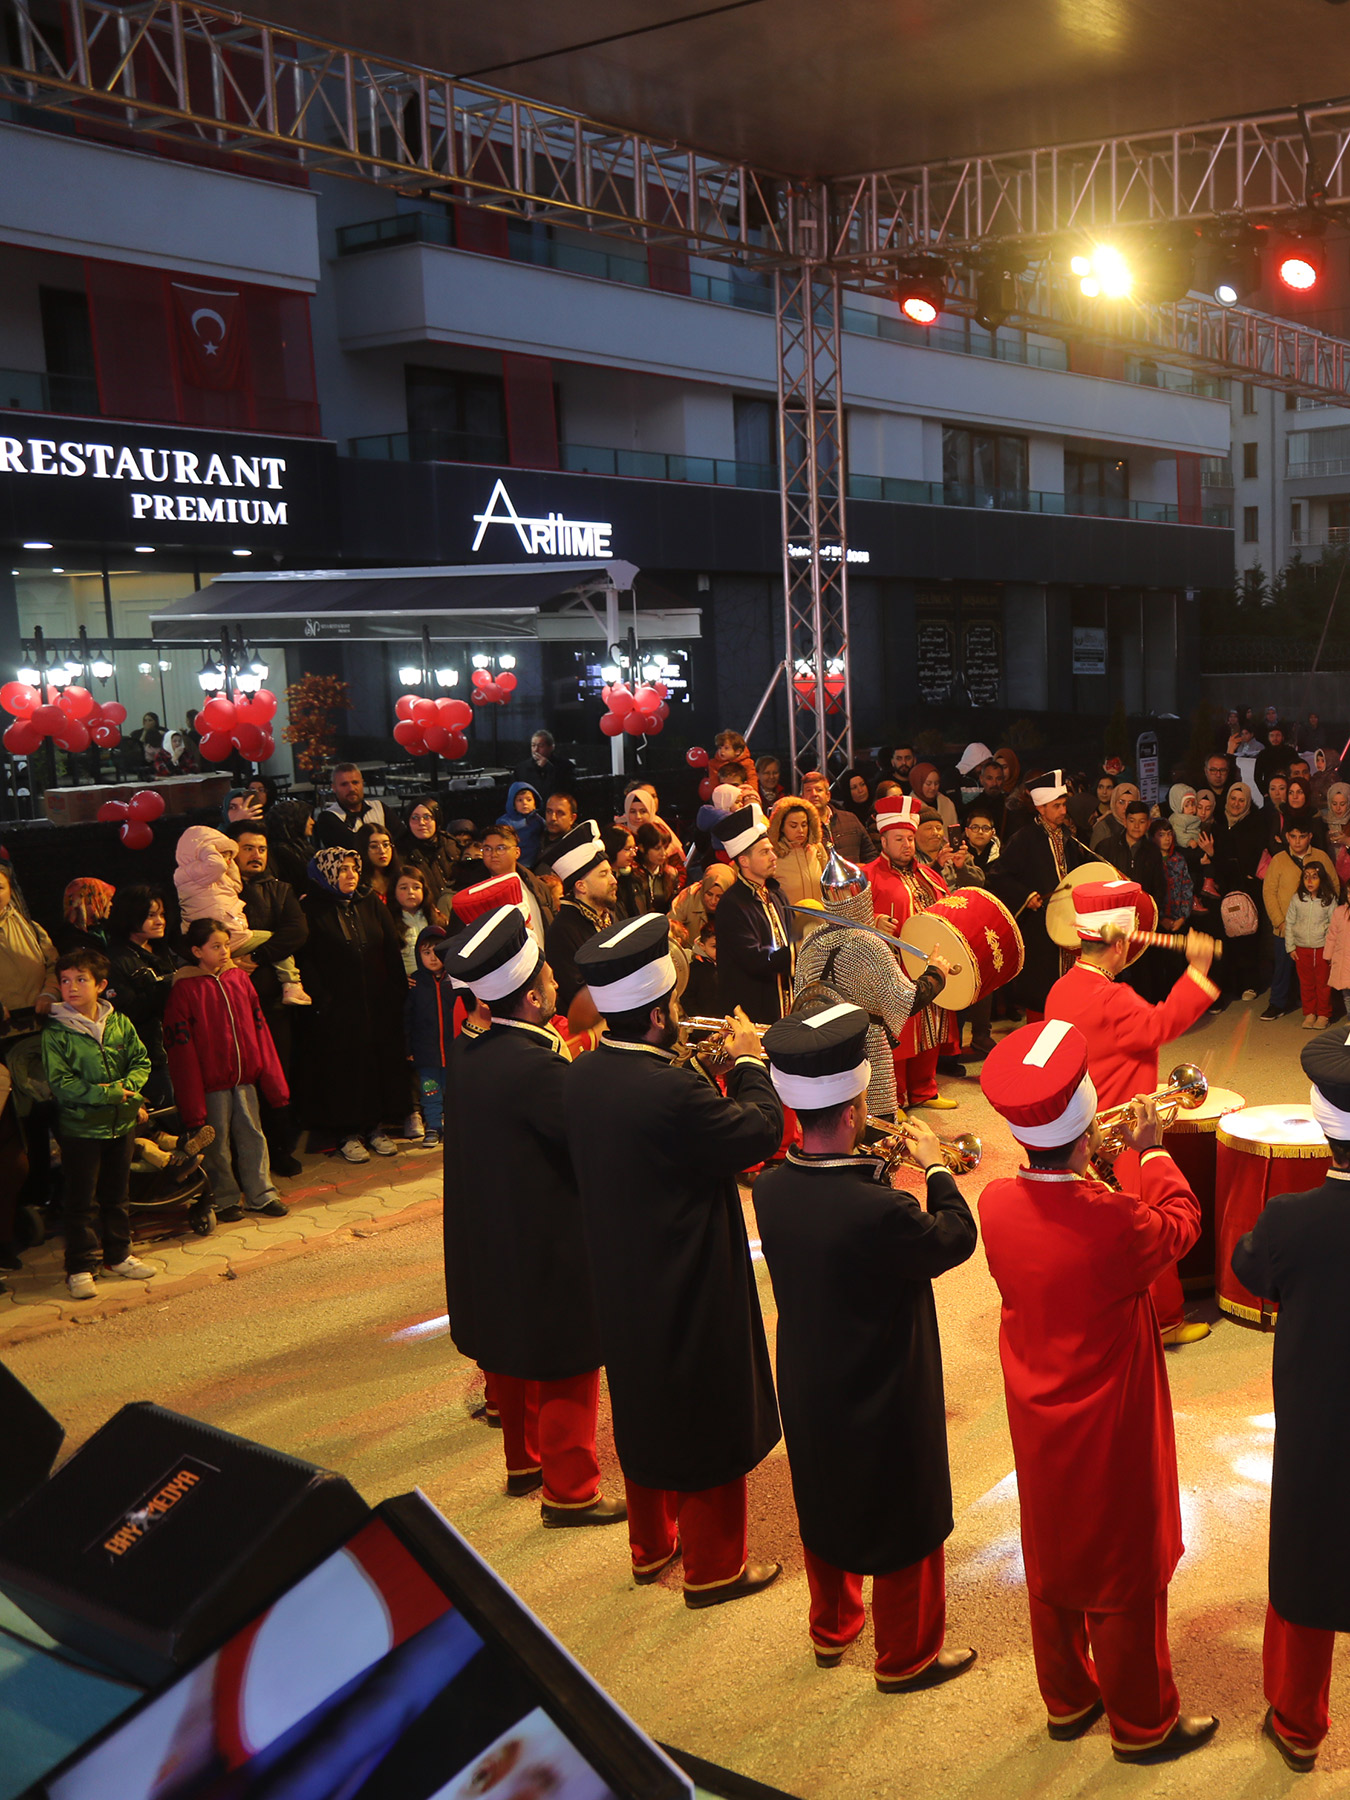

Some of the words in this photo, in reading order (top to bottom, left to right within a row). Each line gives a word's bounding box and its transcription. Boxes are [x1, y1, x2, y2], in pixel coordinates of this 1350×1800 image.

[0, 436, 286, 490] RESTAURANT
[131, 493, 289, 525] PREMIUM
[104, 1522, 143, 1555] BAY
[148, 1470, 200, 1517] MEDYA
